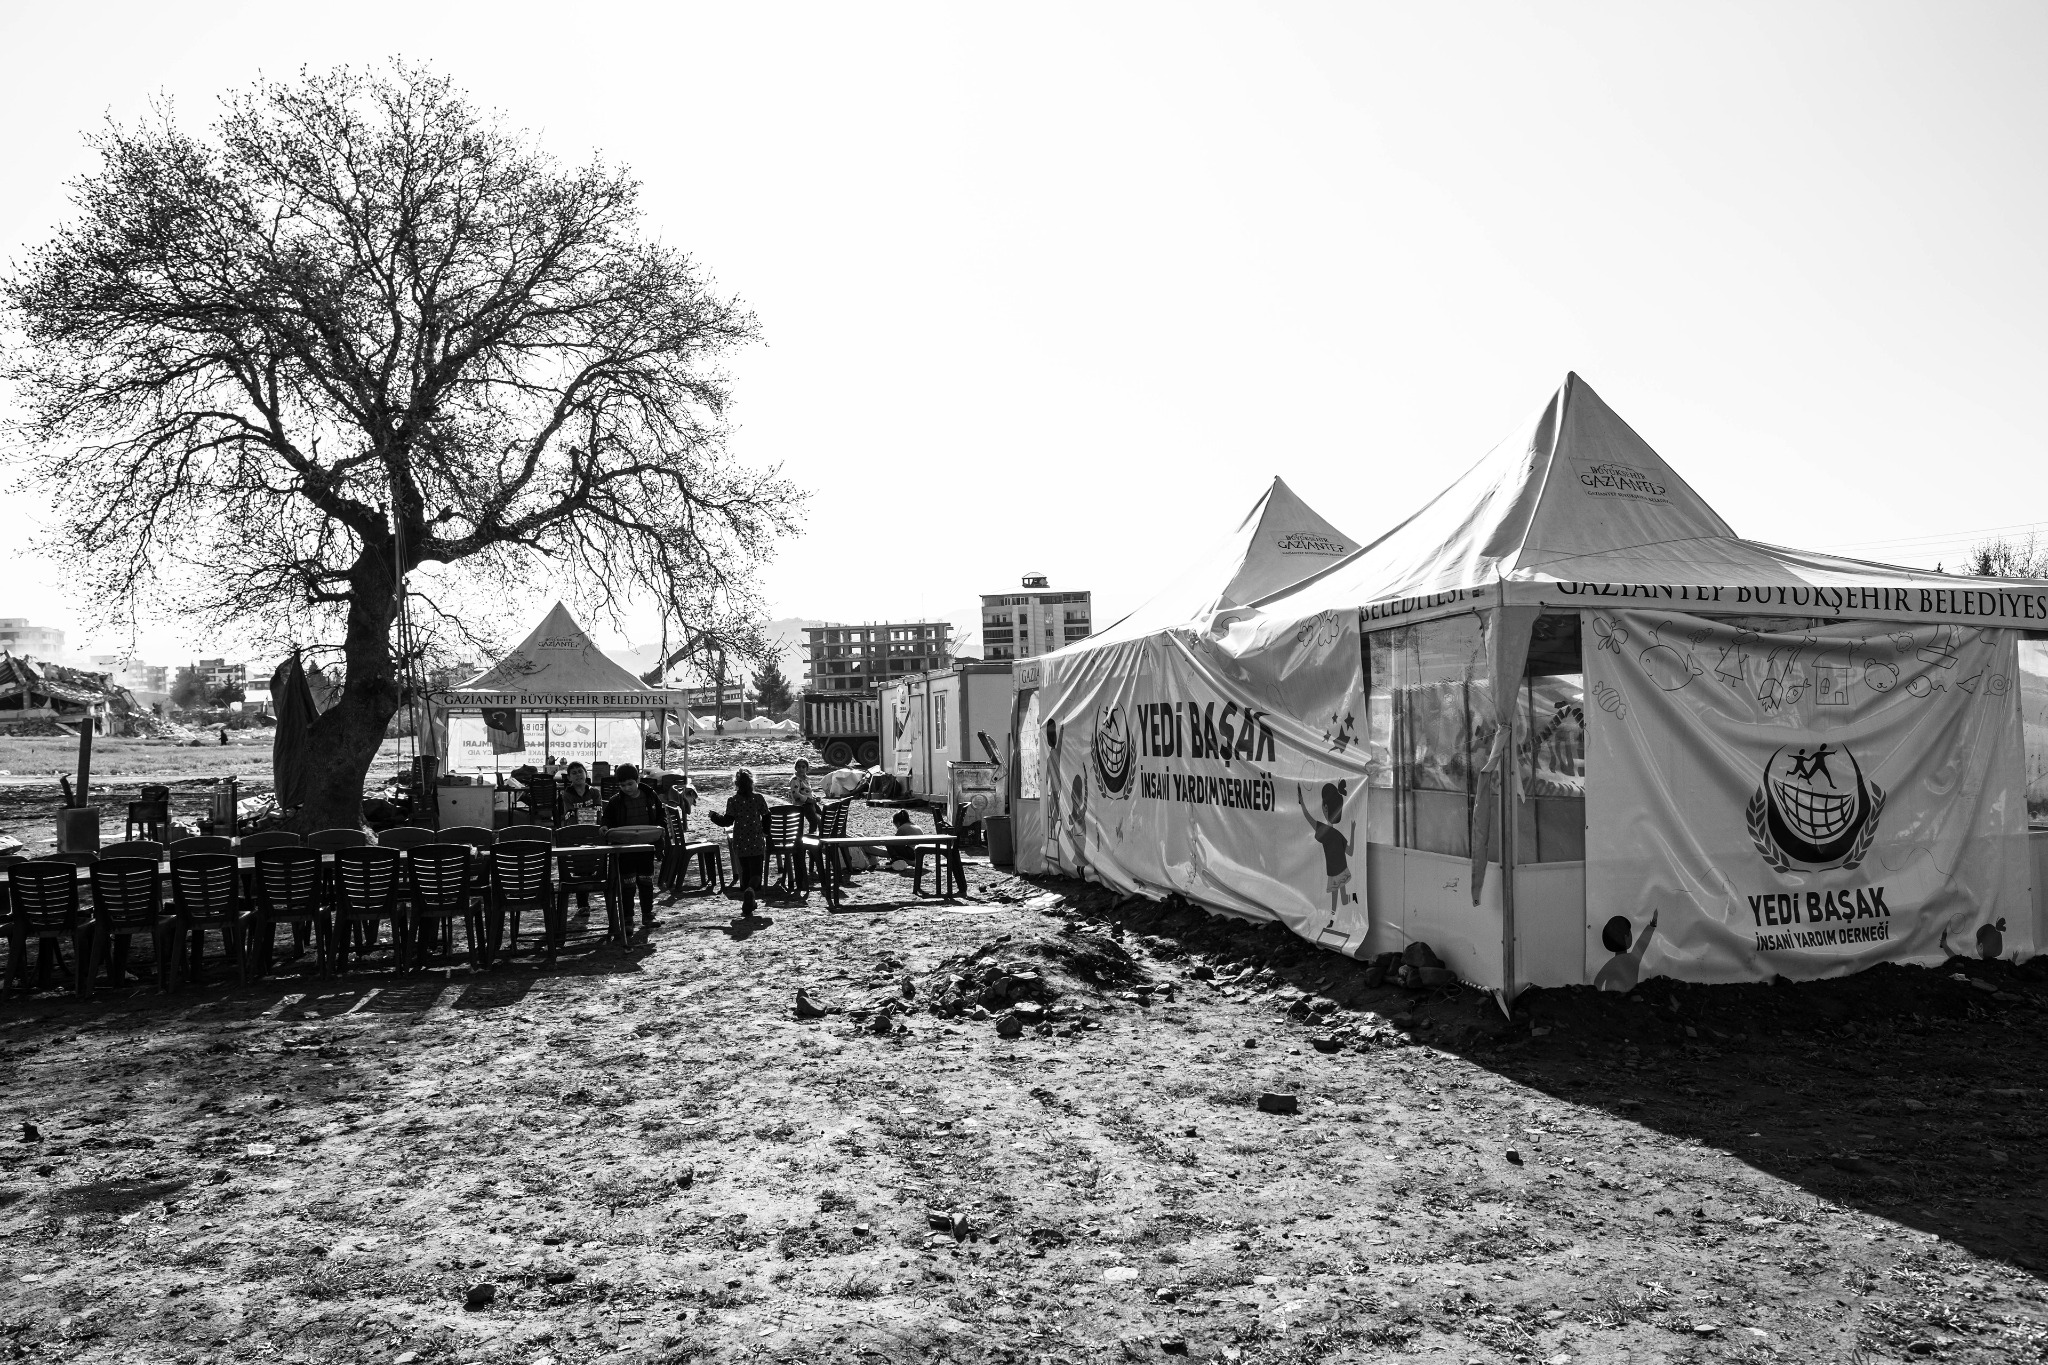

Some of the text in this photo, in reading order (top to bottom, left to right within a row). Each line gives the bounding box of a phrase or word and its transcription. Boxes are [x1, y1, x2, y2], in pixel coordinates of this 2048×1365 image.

[1918, 588, 2047, 620] BELEDİYES
[520, 693, 599, 706] BÜYÜKŞEHİR
[1173, 773, 1219, 805] YARDIM
[1806, 887, 1891, 924] BAŞAK
[1756, 921, 1890, 951] İNSANİ YARDIM DERNEĞİ
